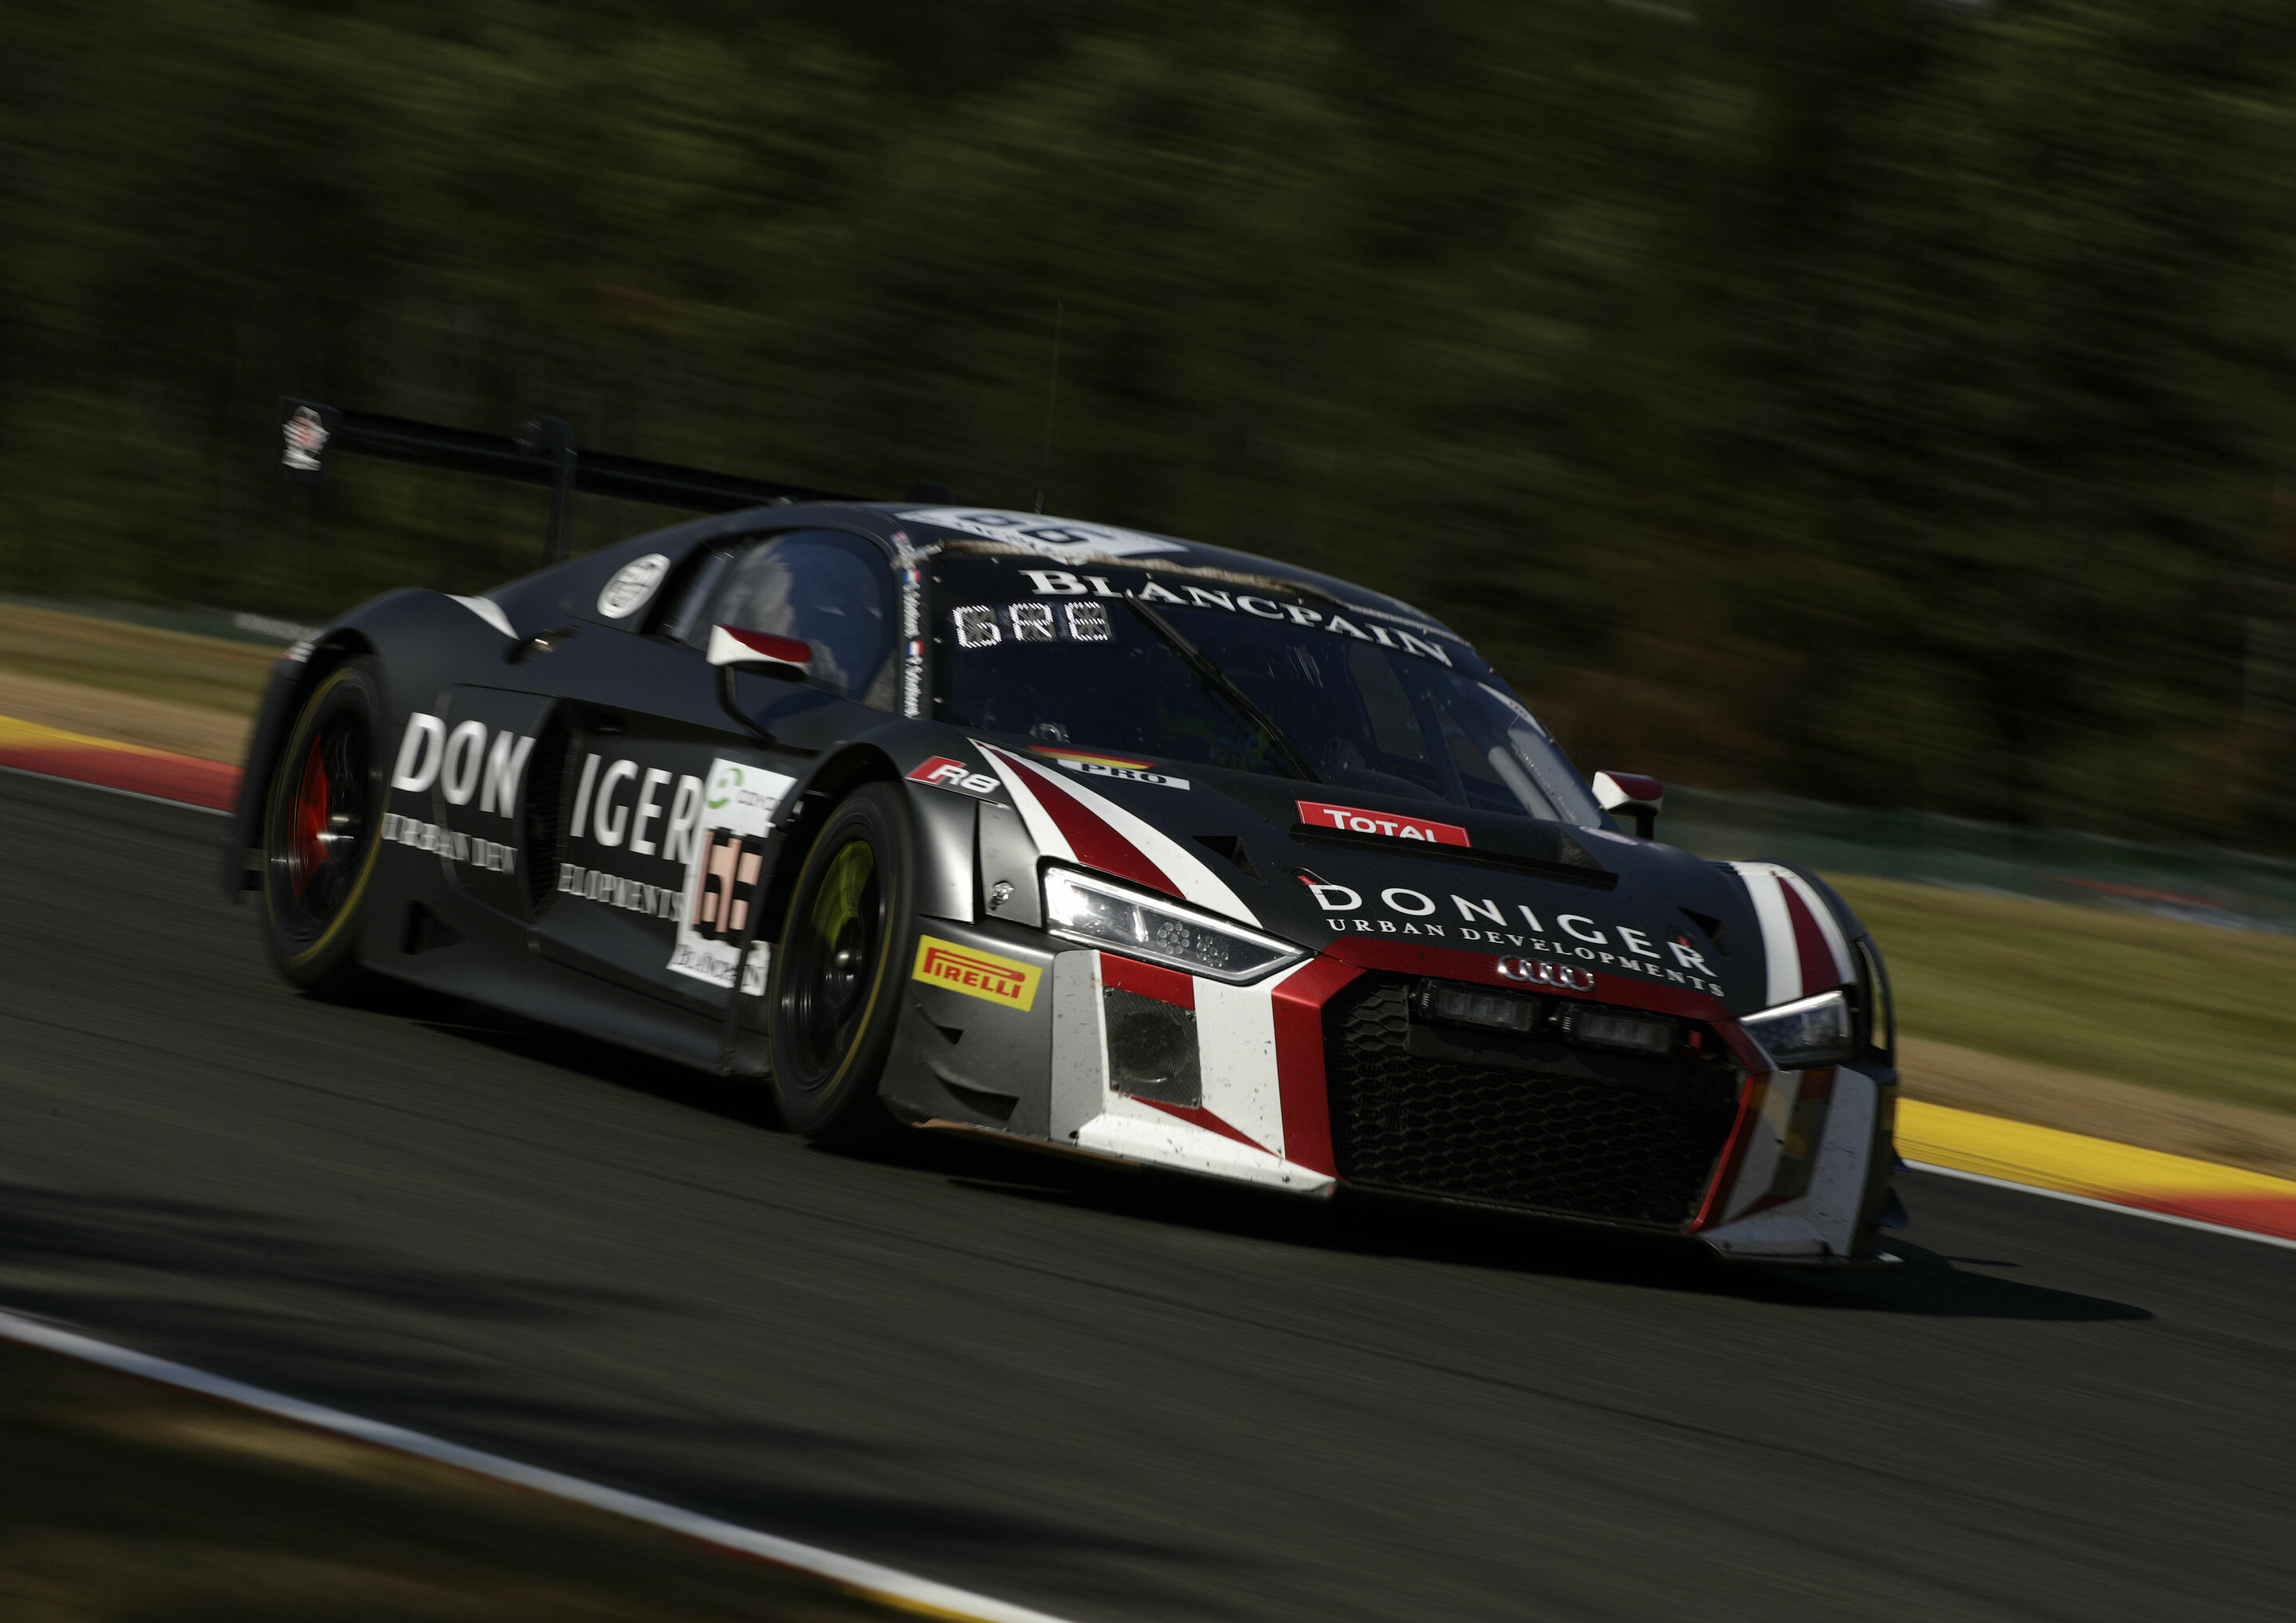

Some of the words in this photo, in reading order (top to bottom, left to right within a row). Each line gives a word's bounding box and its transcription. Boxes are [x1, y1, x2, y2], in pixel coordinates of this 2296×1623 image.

[952, 600, 1113, 650] GRE
[1016, 568, 1453, 669] BLANCPAIN
[930, 764, 1001, 795] R8
[1081, 762, 1167, 784] PRO
[1322, 808, 1437, 843] TOTAL
[1308, 882, 1720, 978] DONIGER
[922, 945, 1027, 1000] PIRELLI
[1324, 917, 1447, 938] URBAN
[1457, 925, 1726, 998] DEVELOPMENTS
